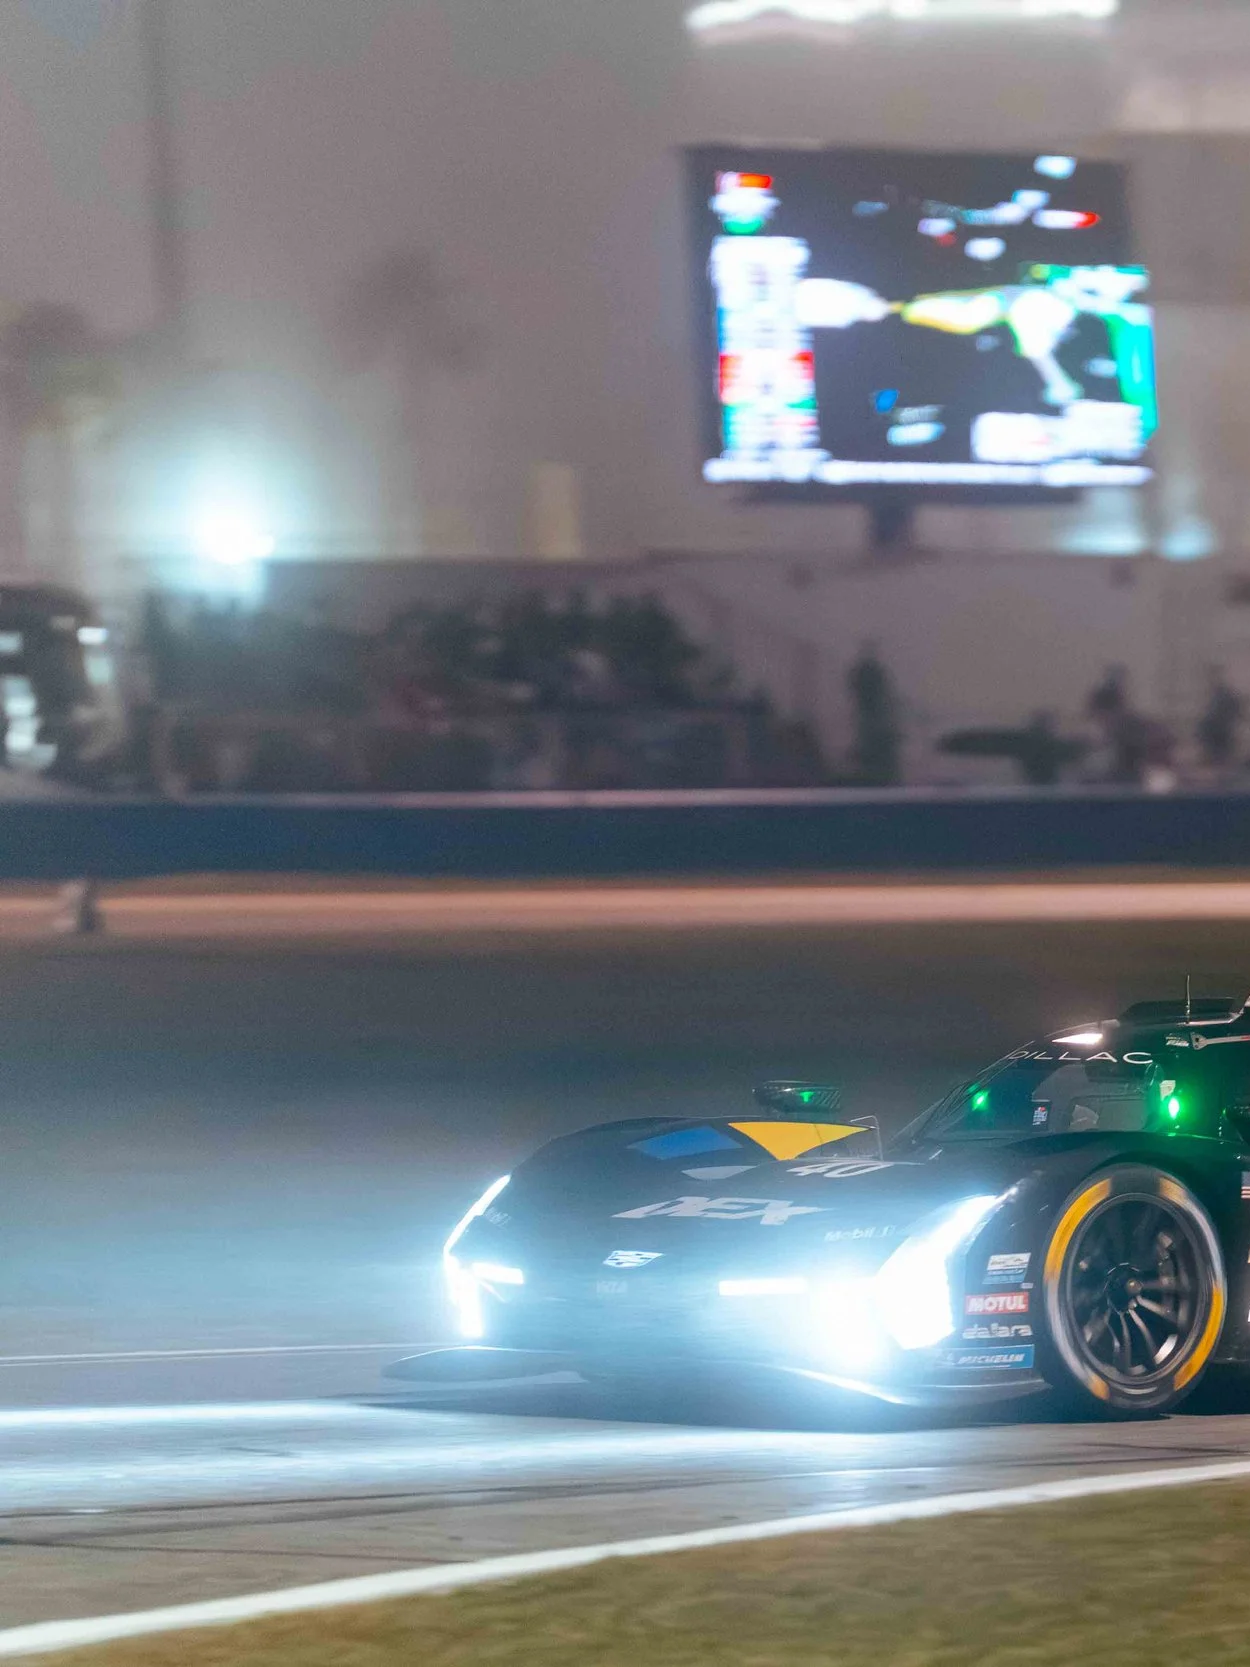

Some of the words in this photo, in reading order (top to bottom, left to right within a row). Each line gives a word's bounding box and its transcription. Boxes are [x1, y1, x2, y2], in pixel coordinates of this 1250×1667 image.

[610, 1196, 838, 1226] DEX
[967, 1295, 1026, 1312] MOTUL
[957, 1353, 1025, 1364] MICHELIN
